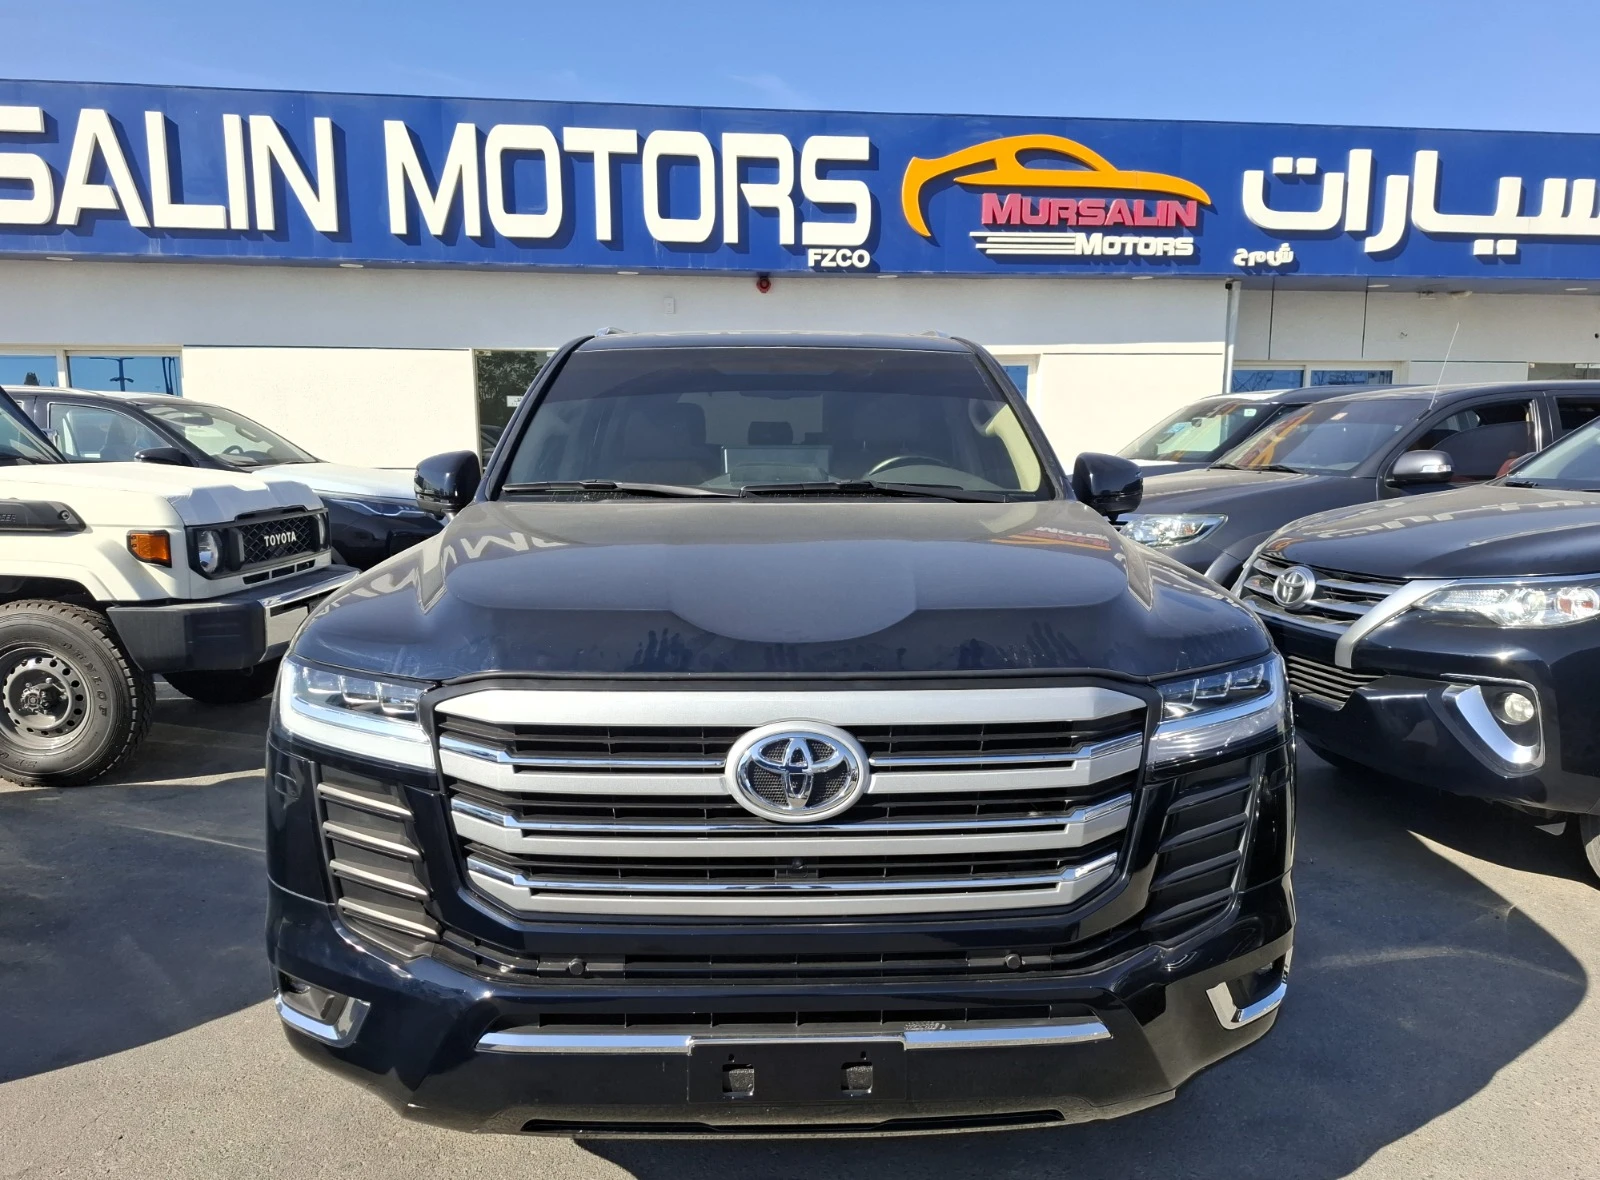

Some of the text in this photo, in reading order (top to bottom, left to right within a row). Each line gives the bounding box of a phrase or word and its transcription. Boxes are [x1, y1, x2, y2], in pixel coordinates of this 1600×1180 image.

[0, 105, 872, 246] SALIN MOTORS
[981, 192, 1198, 227] MURSALIN
[1074, 232, 1194, 256] MOTORS
[807, 248, 871, 268] FZCO
[263, 531, 297, 547] TOYOTA
